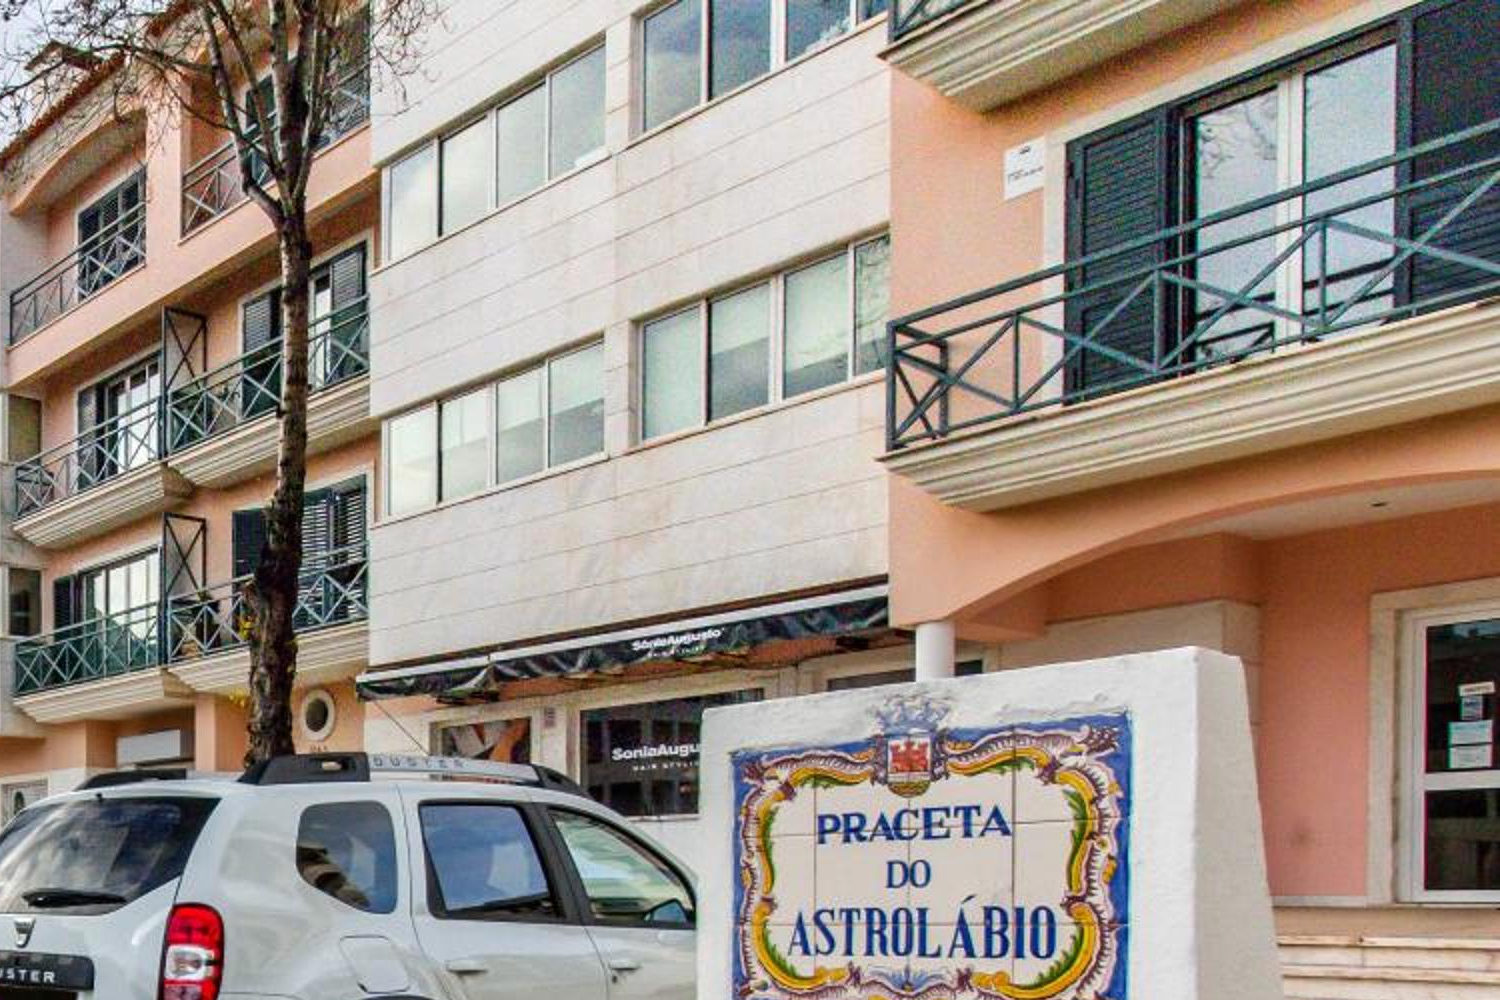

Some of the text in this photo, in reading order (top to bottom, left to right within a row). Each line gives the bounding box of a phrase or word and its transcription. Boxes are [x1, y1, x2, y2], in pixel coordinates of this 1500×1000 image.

[611, 743, 700, 761] SoniaAugu
[816, 804, 1013, 845] PRACETA
[885, 859, 931, 889] DO
[787, 894, 1057, 959] ASTROLÁBIO
